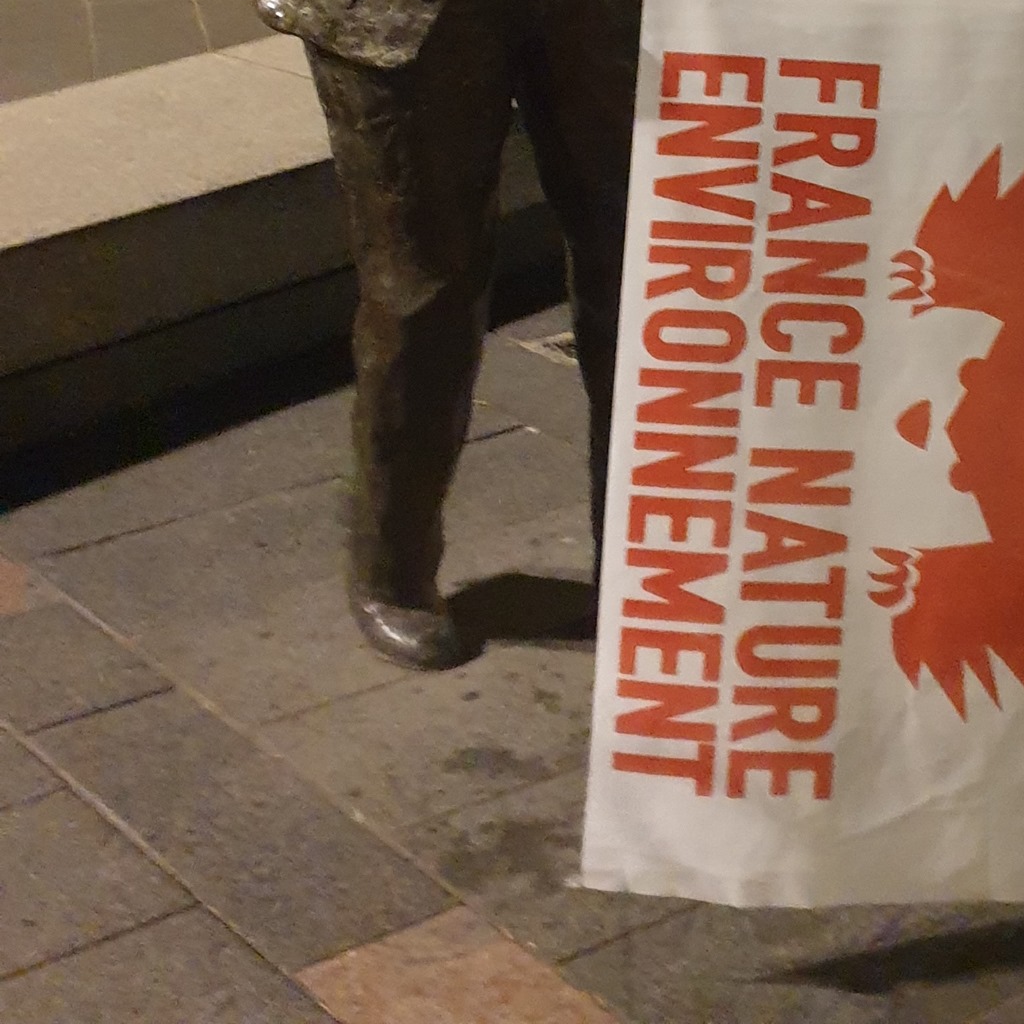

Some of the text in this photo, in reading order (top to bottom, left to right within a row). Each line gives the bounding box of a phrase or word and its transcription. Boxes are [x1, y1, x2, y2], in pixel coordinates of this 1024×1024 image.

[611, 51, 767, 797] ENVIRONNEMENT
[726, 58, 881, 800] FRANCE NATURE
